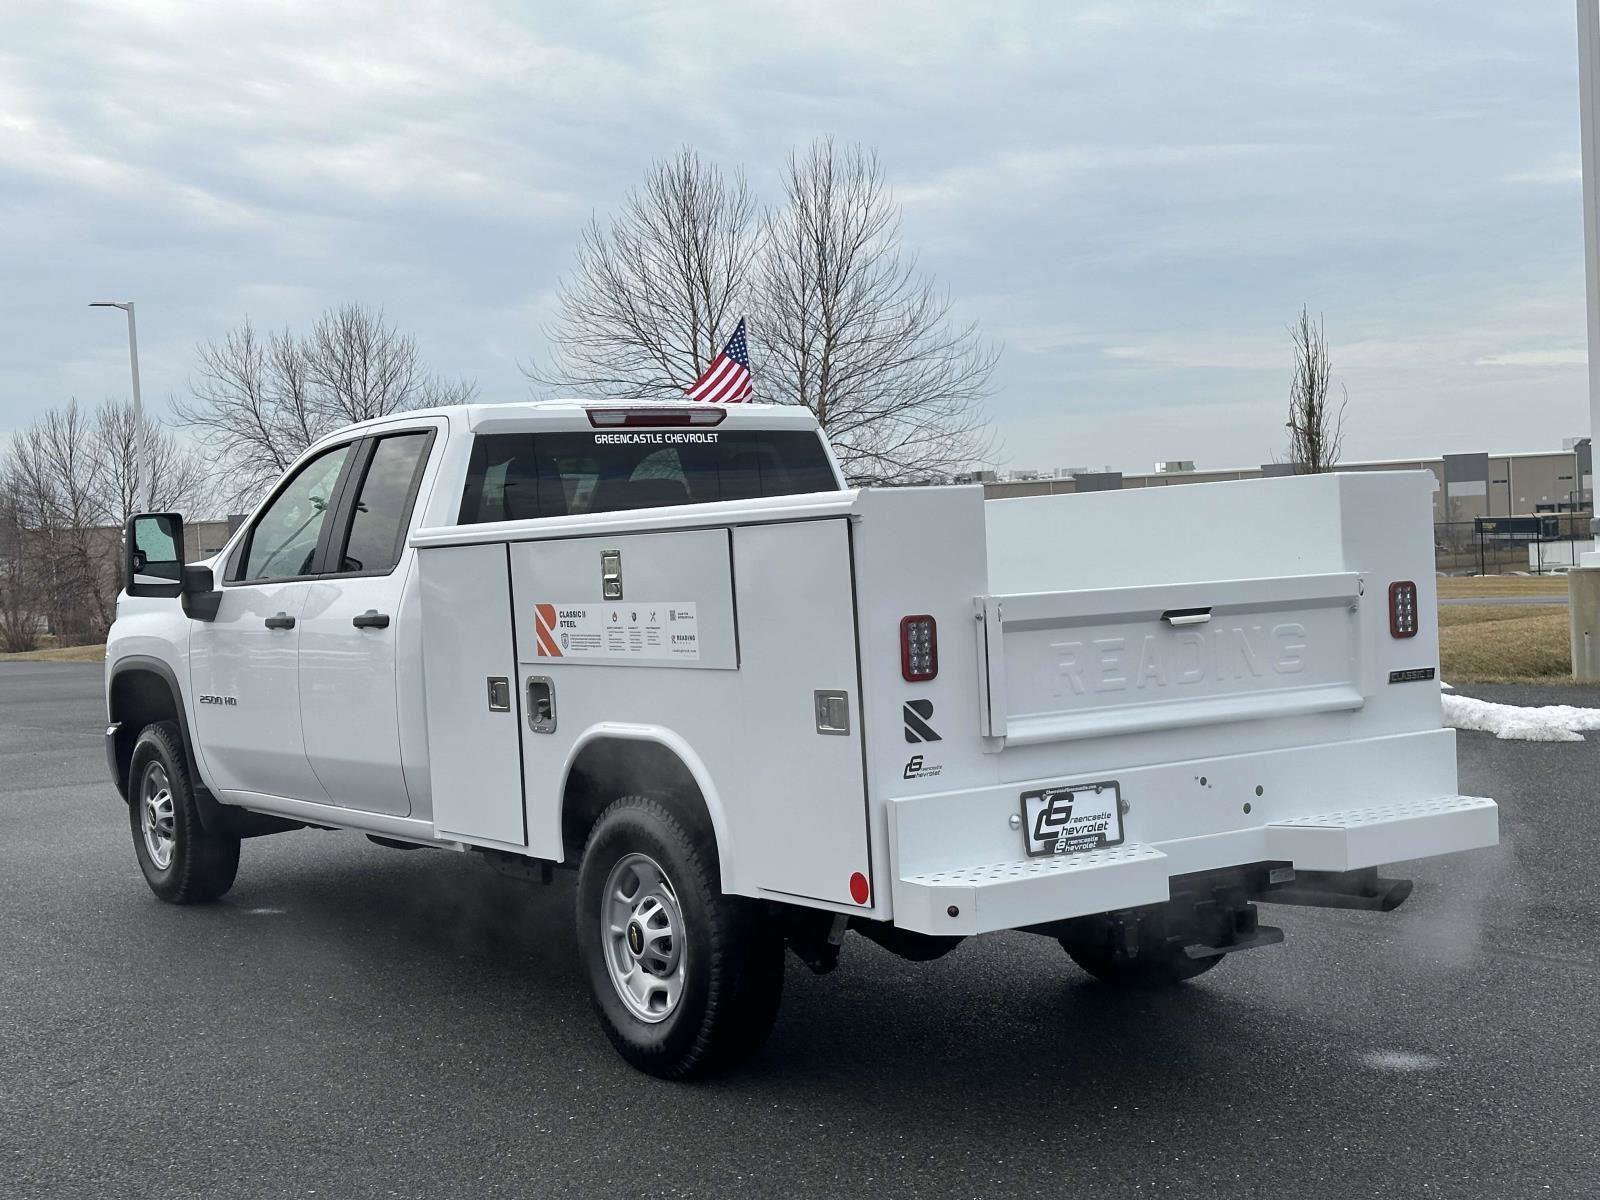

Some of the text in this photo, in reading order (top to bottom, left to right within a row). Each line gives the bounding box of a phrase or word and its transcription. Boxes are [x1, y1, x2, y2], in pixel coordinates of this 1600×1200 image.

[594, 433, 719, 444] GREENCASTLE CHEVROLET
[560, 620, 576, 628] STEEL
[1050, 623, 1307, 697] READING
[199, 695, 237, 706] 2500 HD
